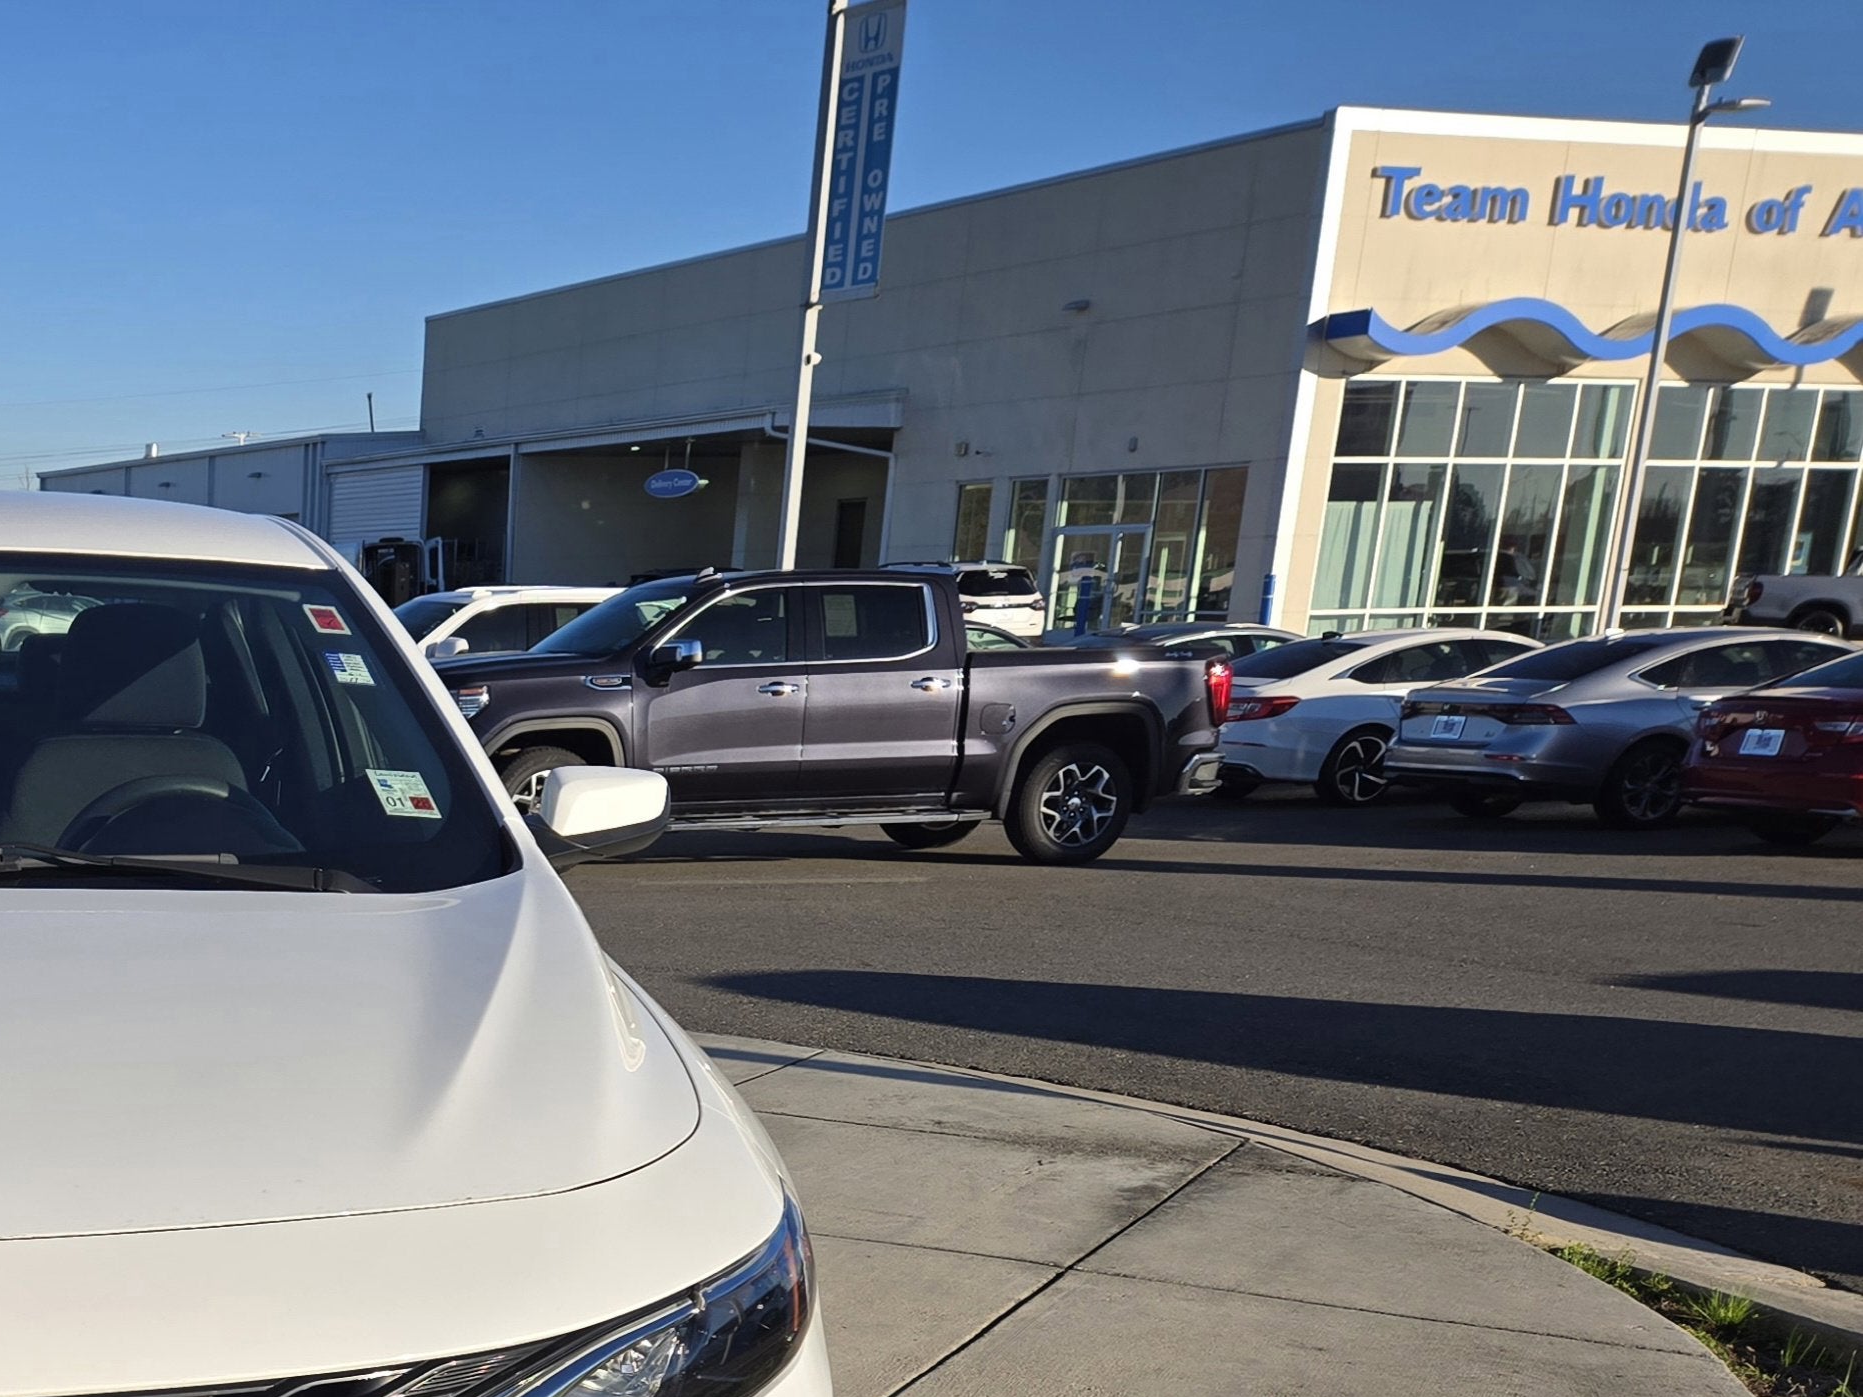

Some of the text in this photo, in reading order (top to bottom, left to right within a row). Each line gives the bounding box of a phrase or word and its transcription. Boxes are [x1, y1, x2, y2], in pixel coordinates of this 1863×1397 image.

[845, 52, 894, 72] HONDA
[824, 82, 860, 286] CERTIFIED
[857, 74, 891, 281] PRE OWNED
[1373, 165, 1530, 222] Team
[1550, 174, 1729, 232] Honda
[1746, 184, 1813, 235] of
[385, 796, 405, 807] 01
